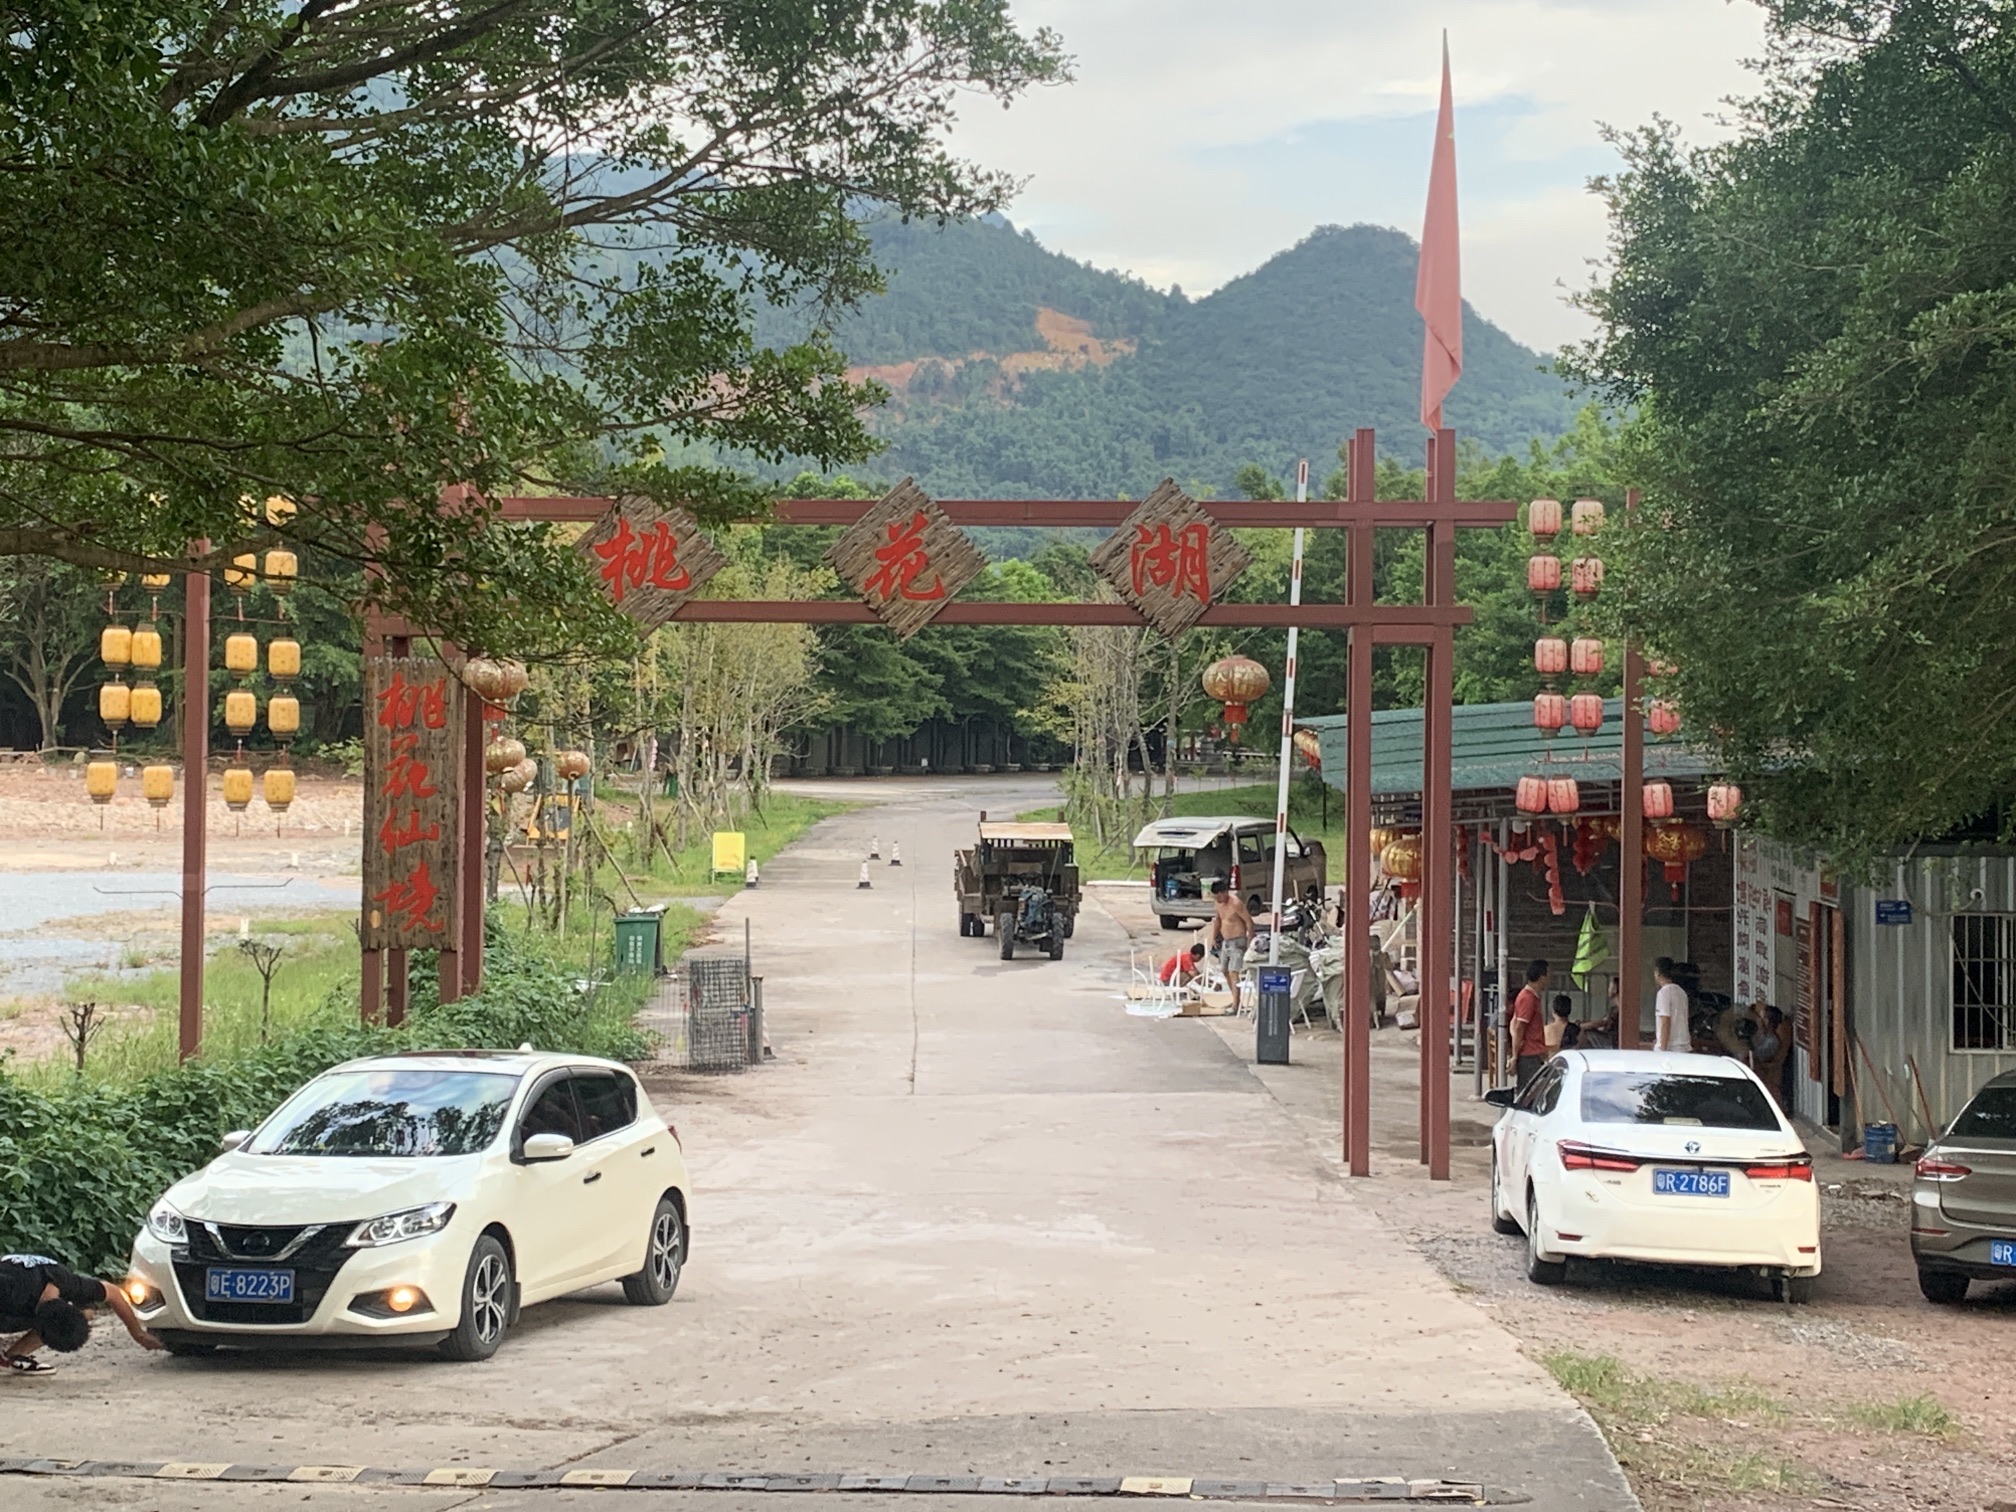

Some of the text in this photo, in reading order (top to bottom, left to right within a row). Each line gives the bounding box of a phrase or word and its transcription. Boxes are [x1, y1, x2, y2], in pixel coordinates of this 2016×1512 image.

[595, 511, 1209, 602] 桃花湖
[373, 672, 448, 933] 桃花仙境
